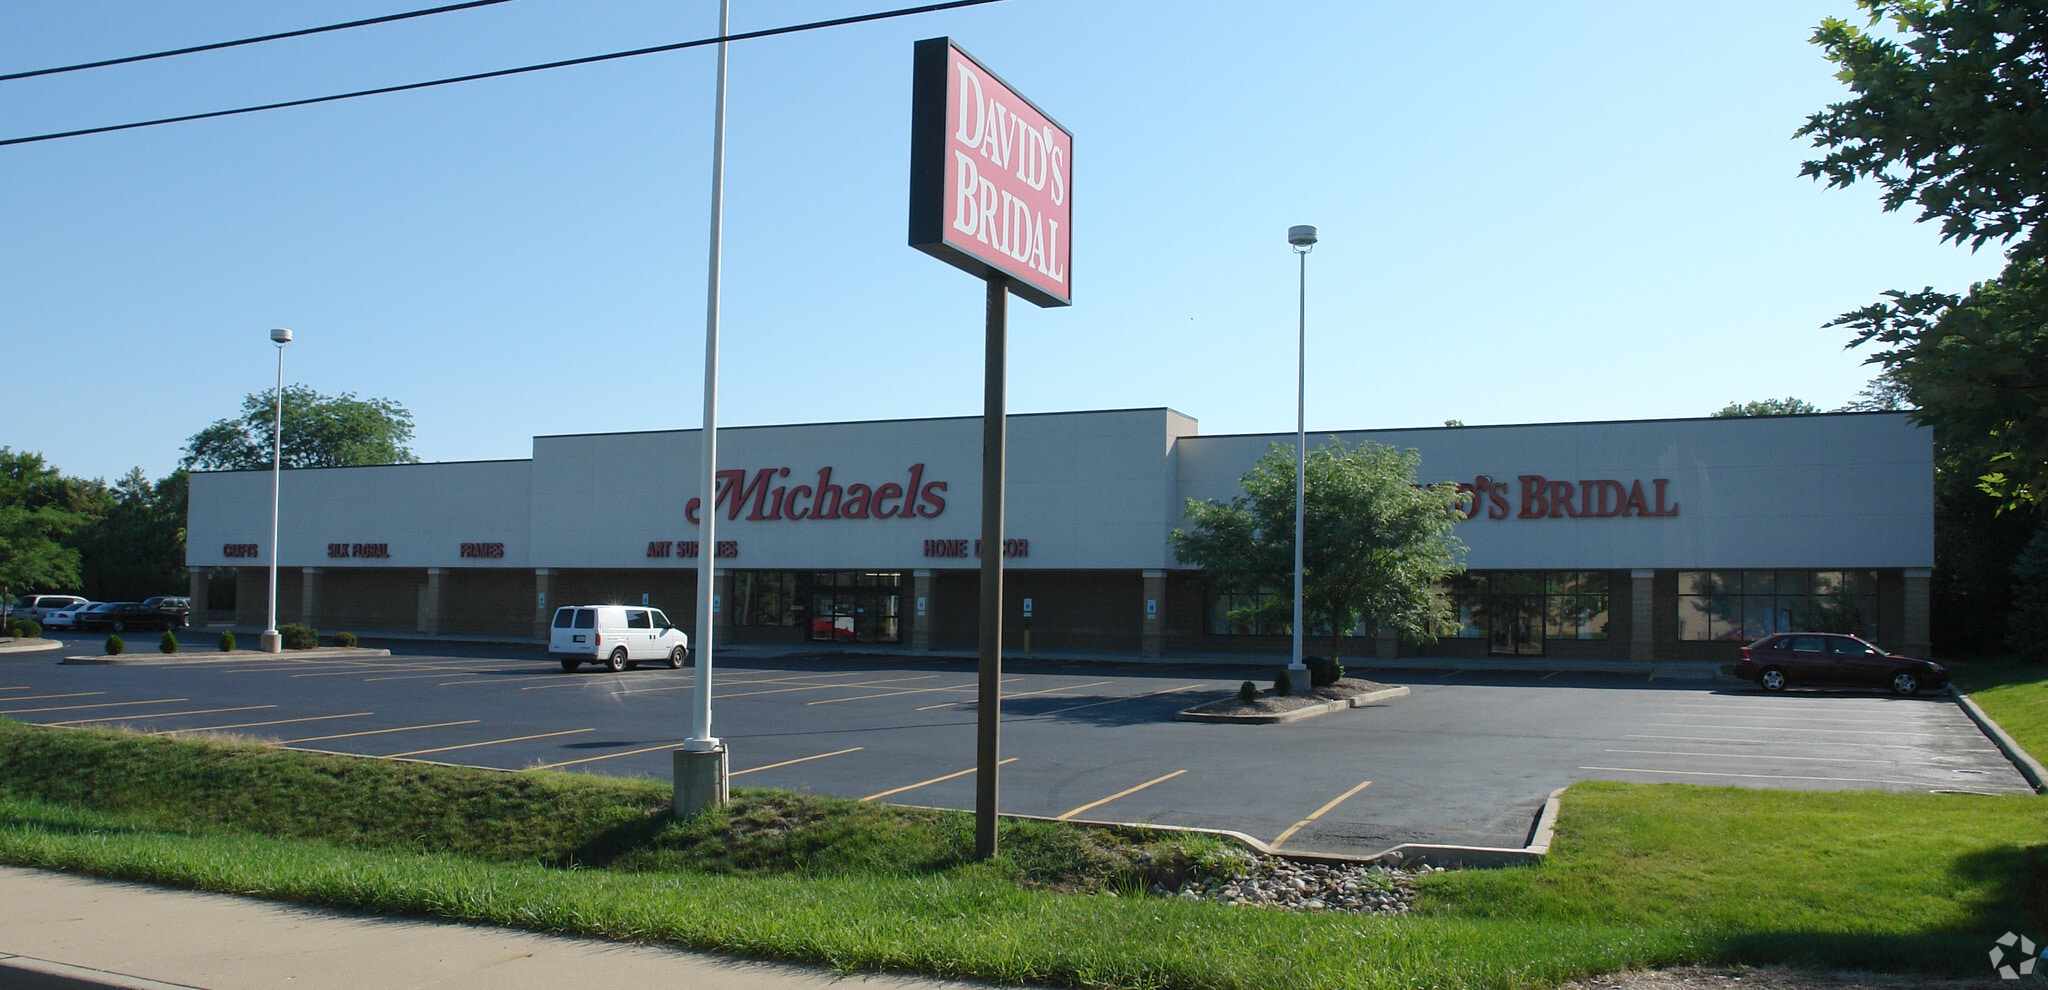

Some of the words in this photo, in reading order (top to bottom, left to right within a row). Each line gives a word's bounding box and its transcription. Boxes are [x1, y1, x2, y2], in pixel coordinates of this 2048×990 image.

[955, 61, 1064, 206] DAVID'S
[953, 149, 1064, 283] BRIDAL
[684, 463, 947, 525] Michaels
[1517, 474, 1679, 519] BRIDAL
[223, 543, 259, 558] CRAFTS
[327, 543, 350, 558] SILK
[352, 543, 390, 559] FLORAL
[459, 542, 504, 558] FRAMES
[646, 541, 672, 558] ART
[676, 540, 738, 559] SUPIES
[923, 539, 968, 558] HOME
[974, 538, 1028, 558] DOR
